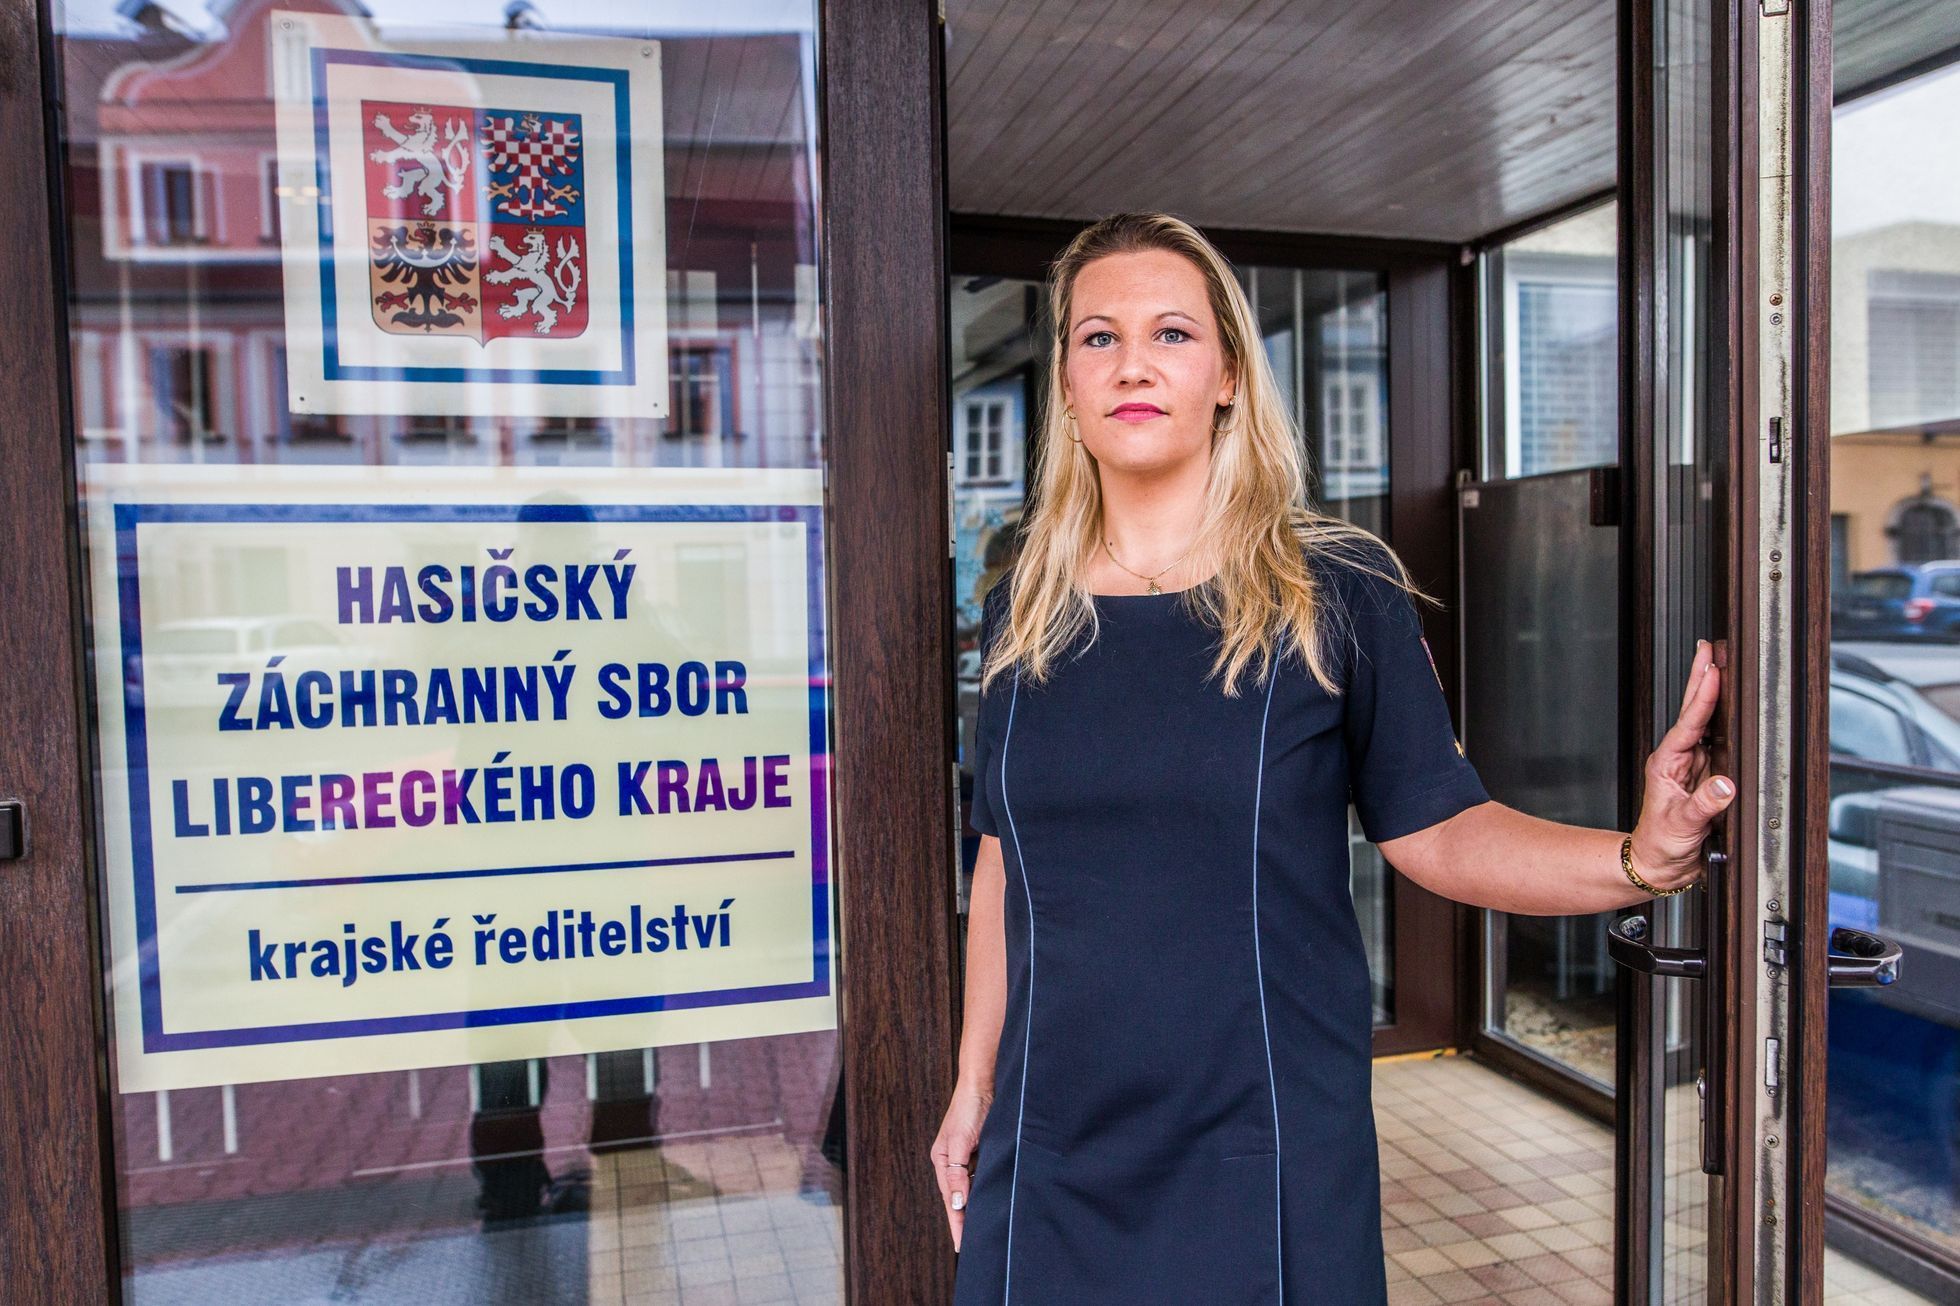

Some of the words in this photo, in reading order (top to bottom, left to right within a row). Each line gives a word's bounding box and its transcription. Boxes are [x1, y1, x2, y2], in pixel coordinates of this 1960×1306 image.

[336, 549, 638, 625] HASIČSKÝ
[217, 649, 577, 732] ZÁCHRANNÝ
[597, 660, 749, 720] SBOR
[171, 751, 596, 838] LIBERECKÉHO
[617, 754, 792, 817] KRAJE
[247, 917, 454, 988] krajské
[474, 898, 736, 967] ředitelství
